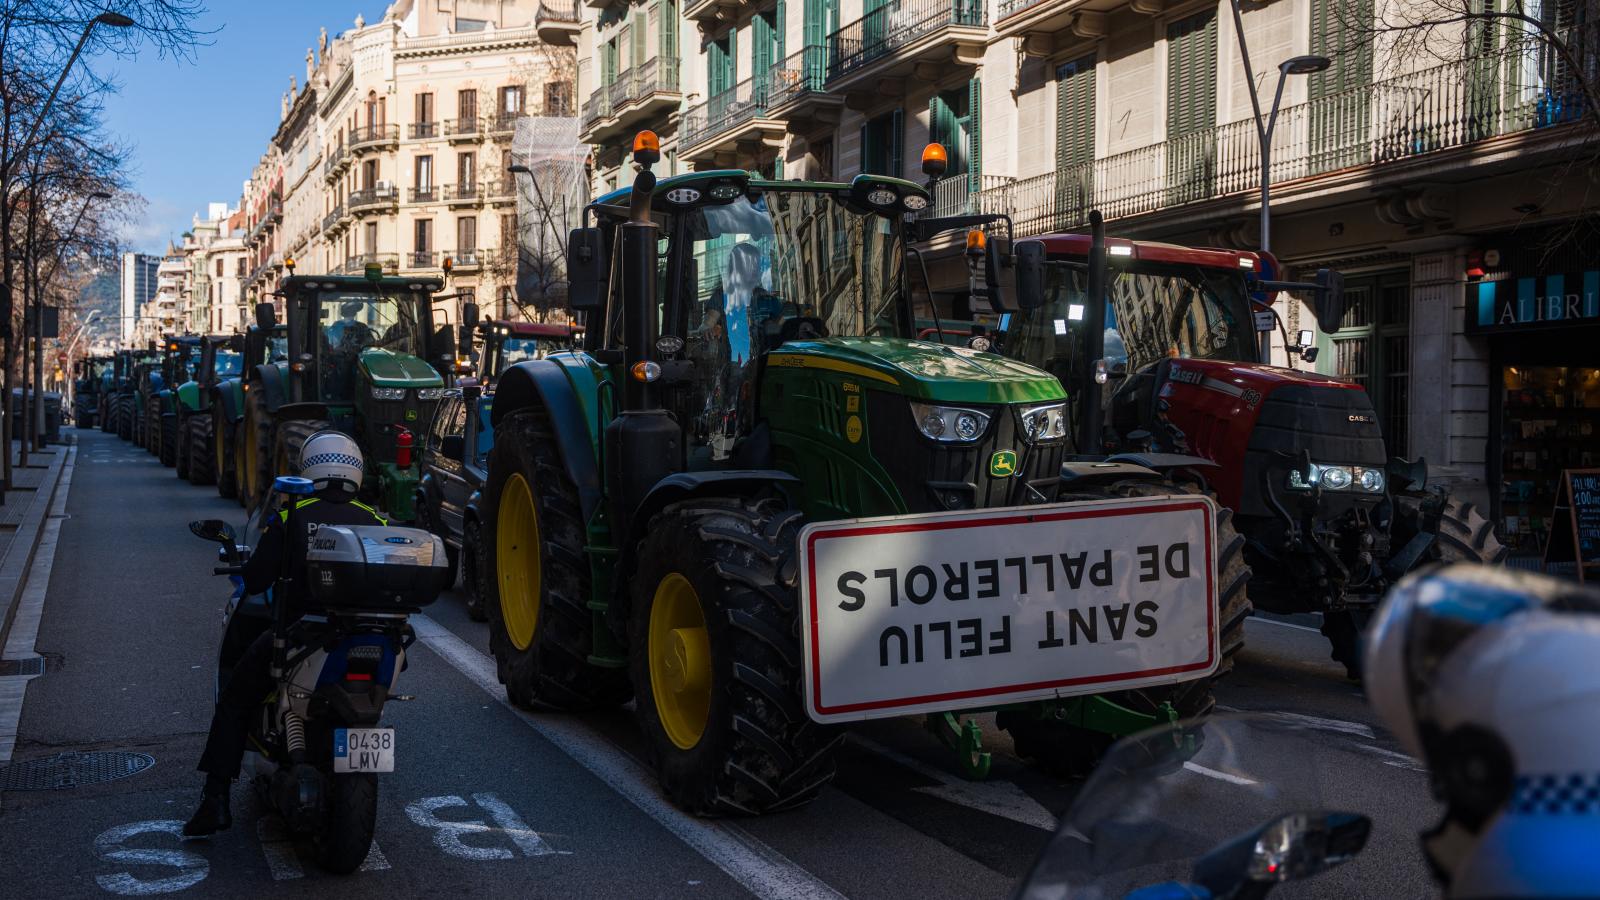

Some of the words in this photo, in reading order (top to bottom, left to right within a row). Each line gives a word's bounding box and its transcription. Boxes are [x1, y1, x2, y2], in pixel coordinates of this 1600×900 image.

[1499, 292, 1594, 325] ALIBRI
[1574, 491, 1592, 505] 100
[321, 570, 334, 582] 112
[1137, 542, 1190, 582] DE
[837, 549, 1113, 612] PALLEROLS
[879, 615, 1011, 667] FELIU
[1038, 600, 1159, 649] SANT
[349, 732, 391, 749] 0438
[349, 751, 380, 769] LMV
